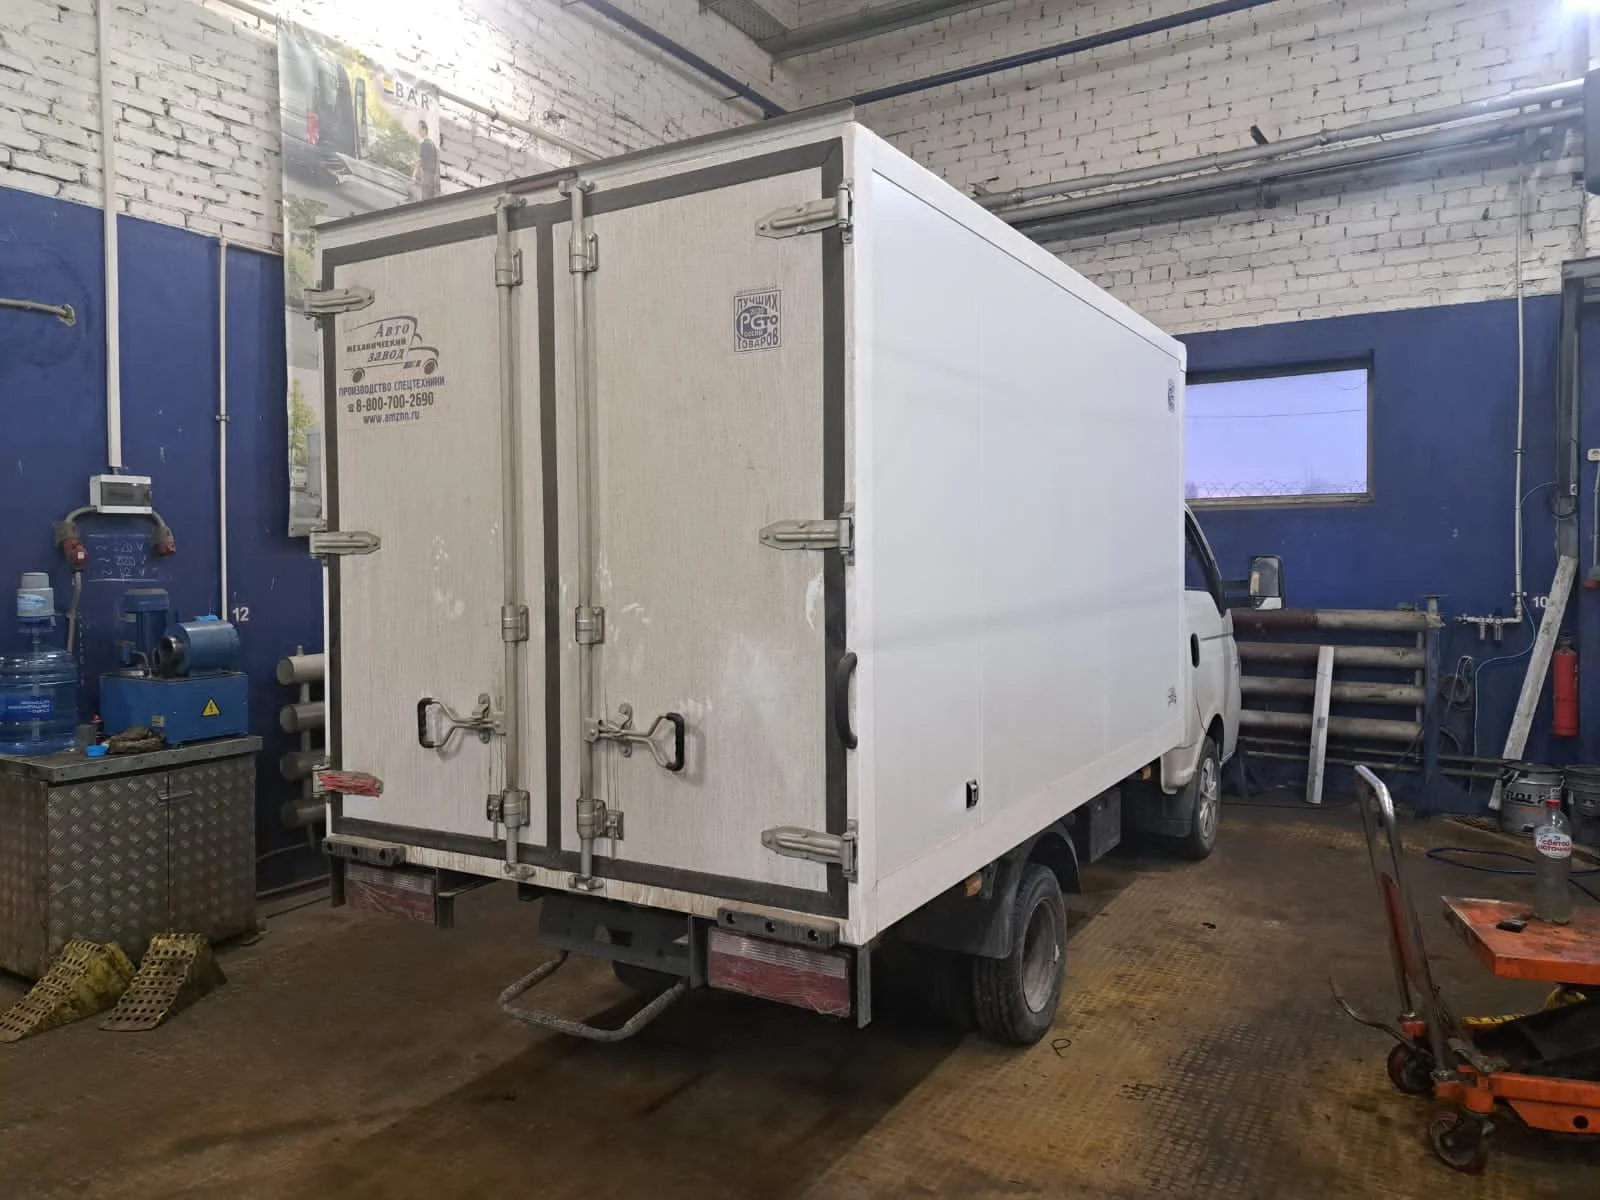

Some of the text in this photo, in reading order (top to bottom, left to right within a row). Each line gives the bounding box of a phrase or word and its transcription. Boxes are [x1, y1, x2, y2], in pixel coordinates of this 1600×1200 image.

[736, 293, 778, 316] ЛУЧШИХ
[737, 327, 779, 349] ТОВАРОВ
[338, 376, 445, 397] ПРОИЗВОДСТВО СПЕЦТЕХНИКИ
[1532, 596, 1549, 608] 10
[232, 606, 249, 622] 12
